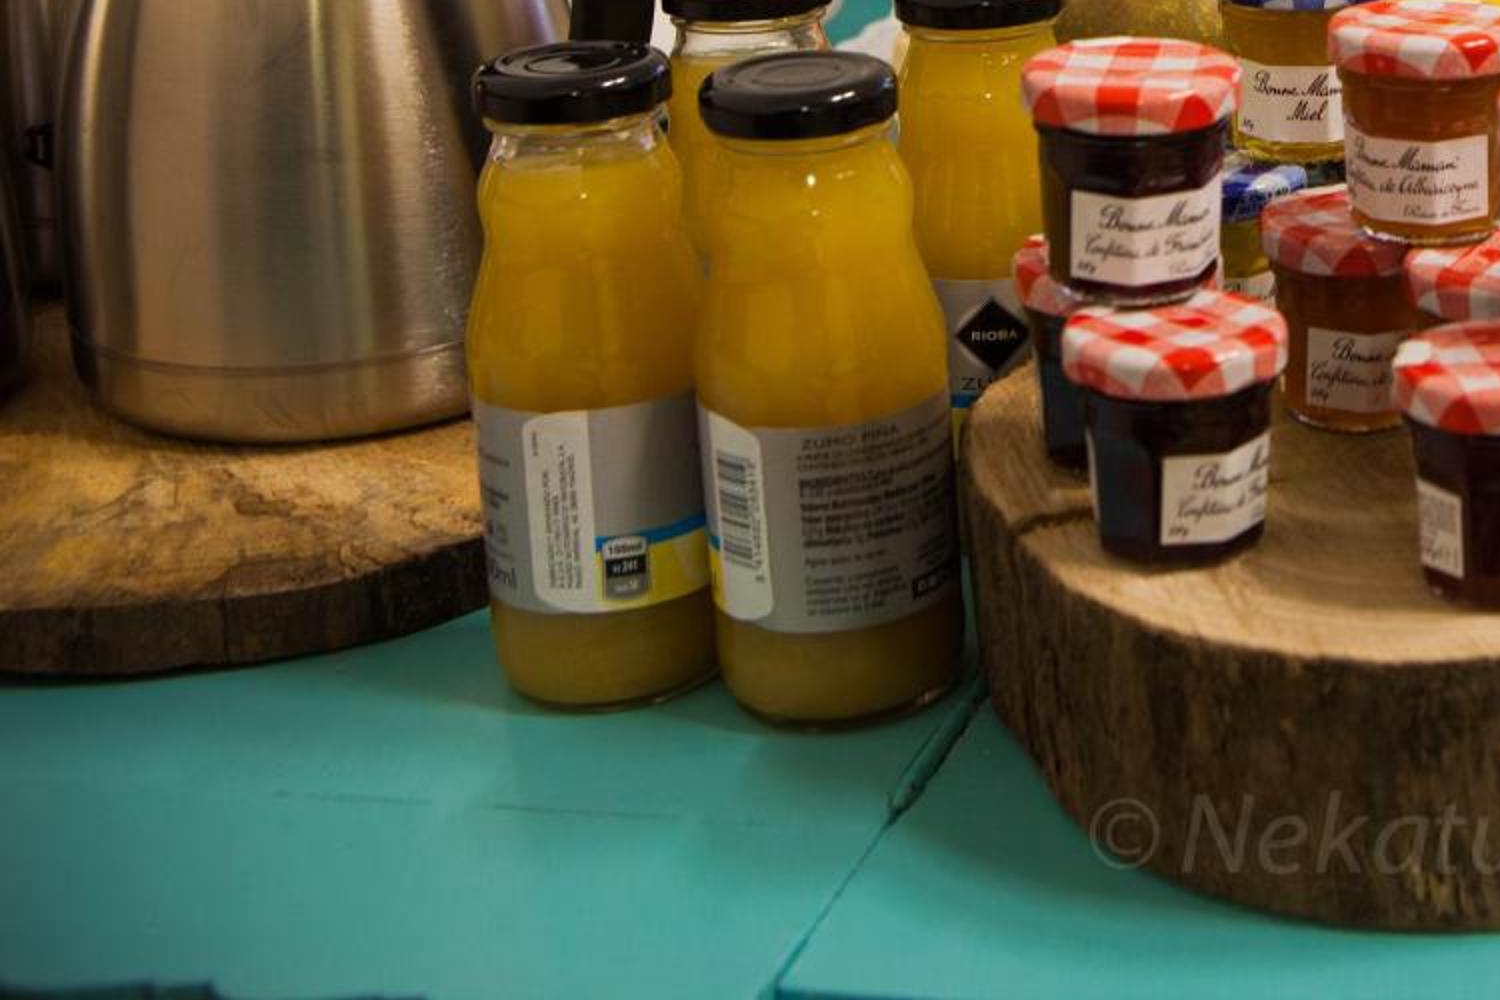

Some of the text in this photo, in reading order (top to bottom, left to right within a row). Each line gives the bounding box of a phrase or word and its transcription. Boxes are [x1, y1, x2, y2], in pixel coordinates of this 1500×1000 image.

[1254, 69, 1298, 96] Bonne
[1285, 99, 1329, 121] Miel
[1392, 145, 1460, 173] Maman
[1098, 203, 1154, 232] Bonne
[1331, 336, 1384, 362] Bonne
